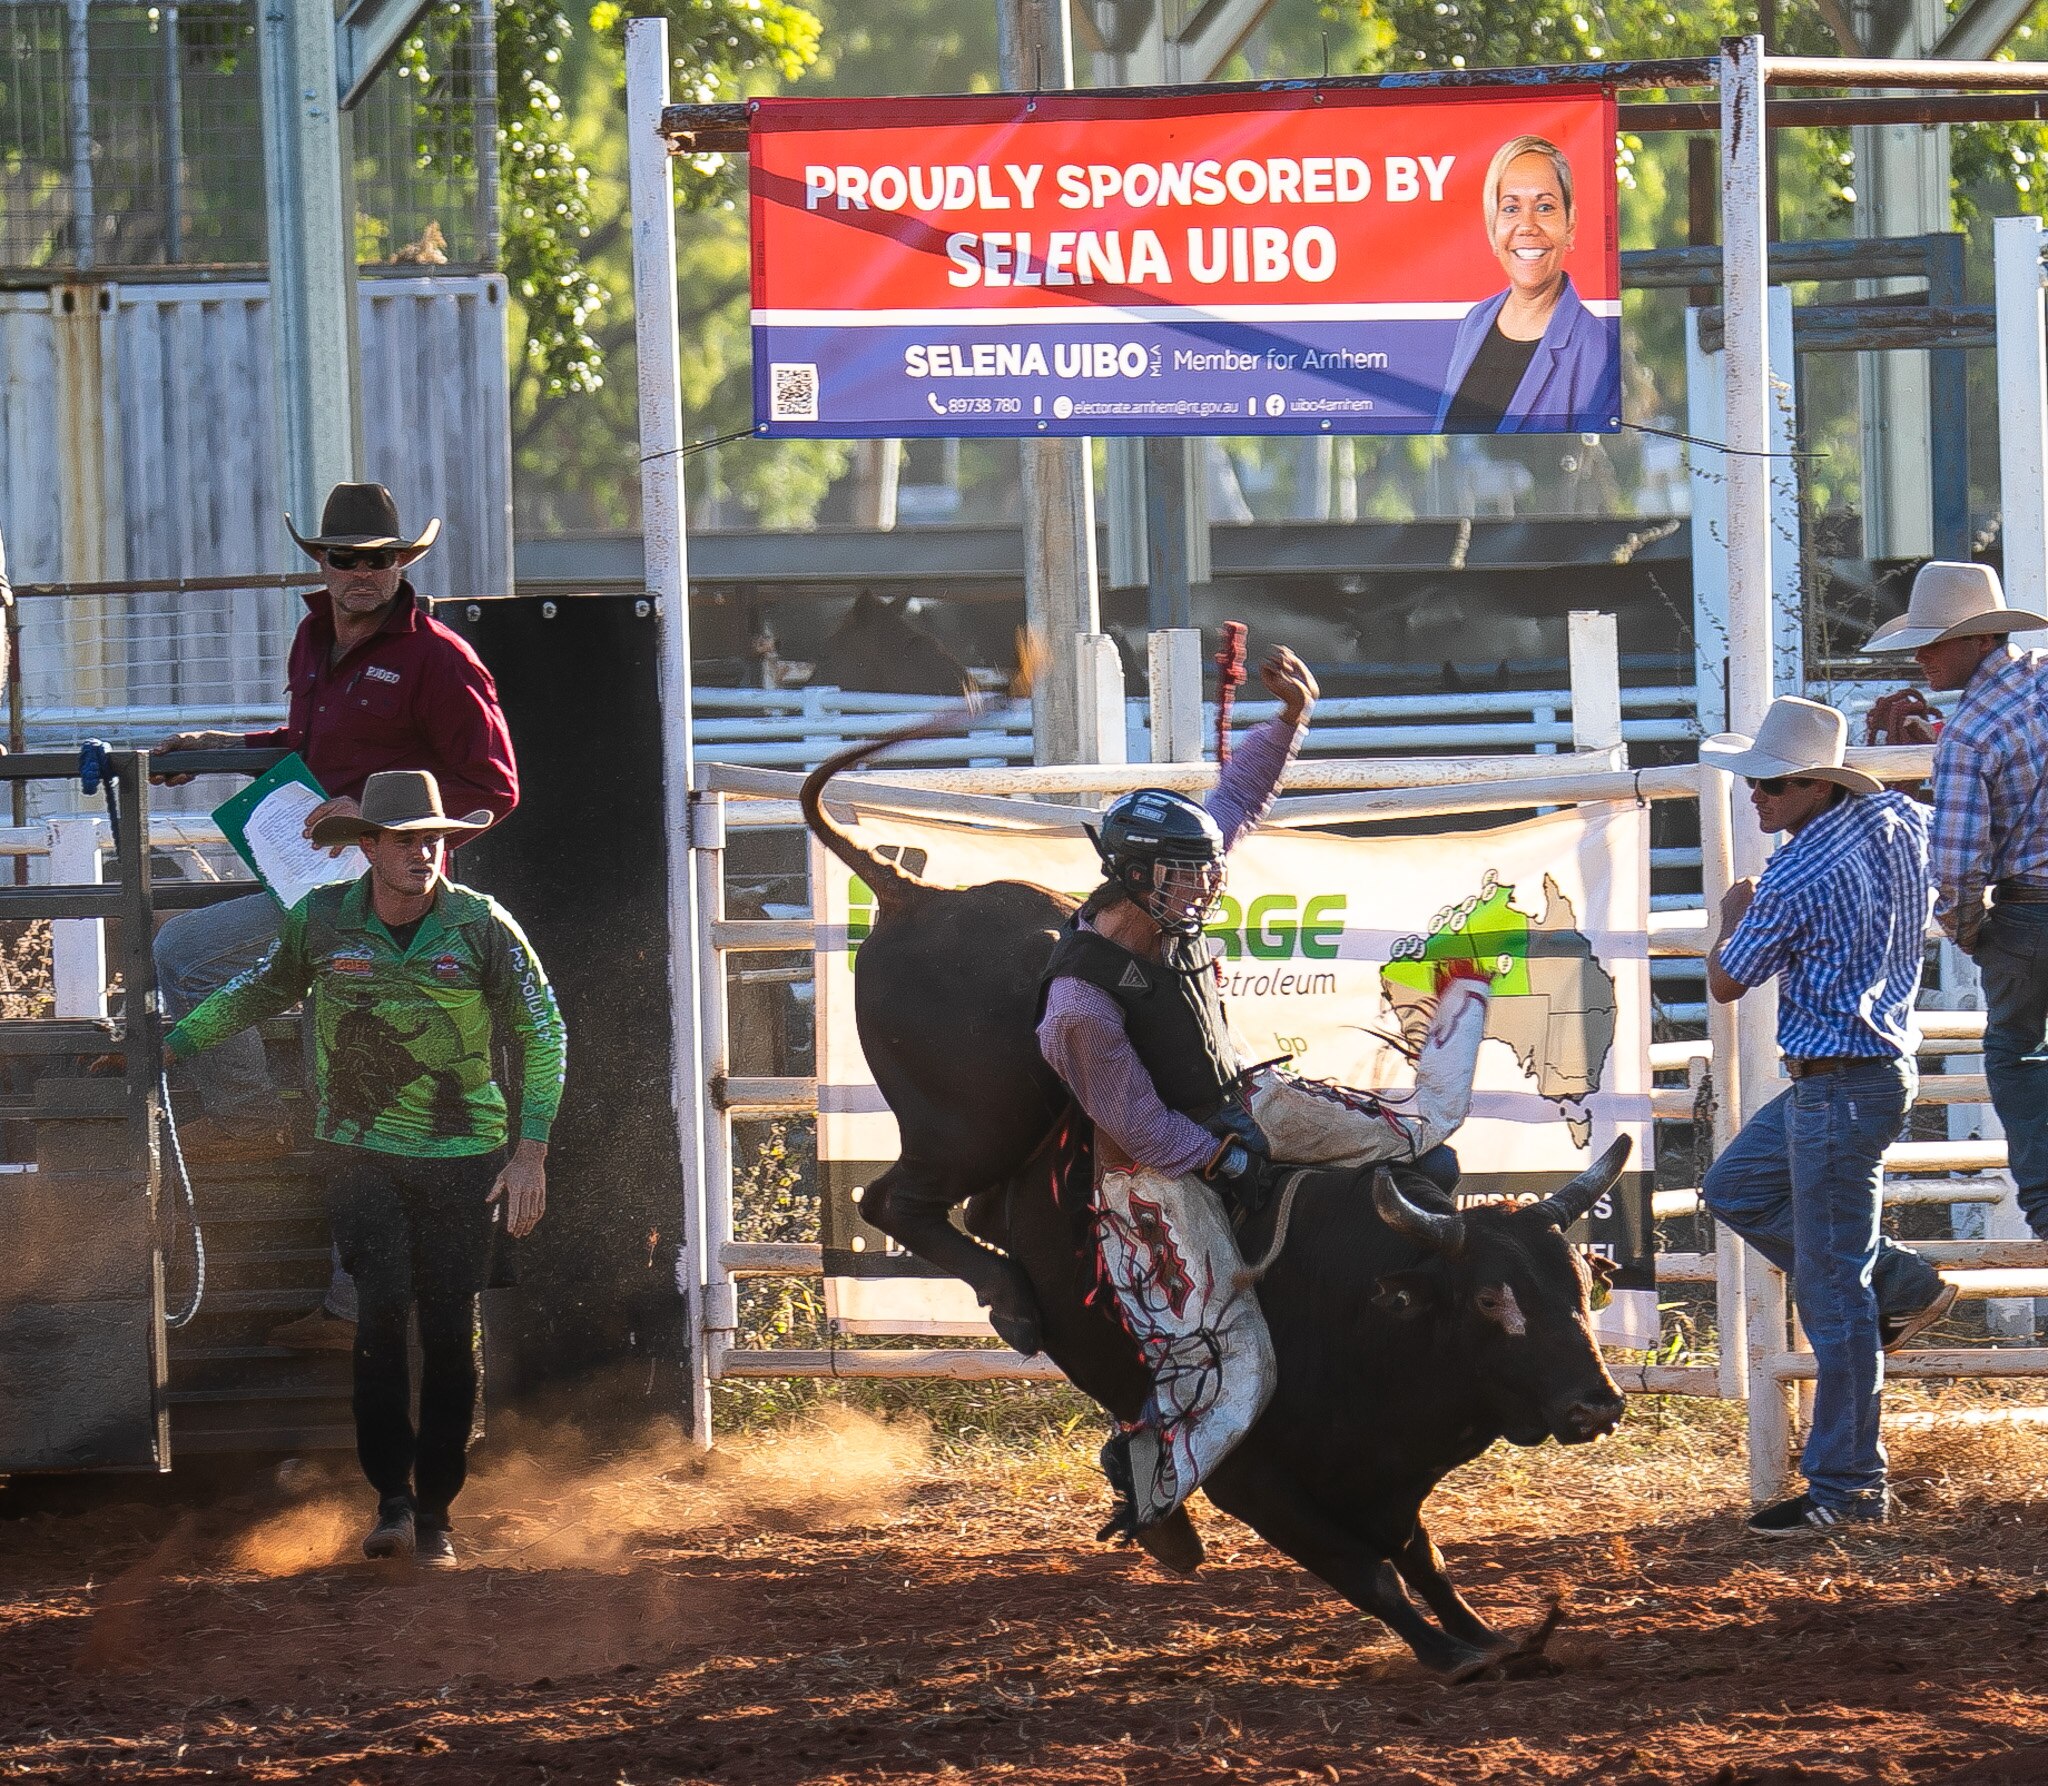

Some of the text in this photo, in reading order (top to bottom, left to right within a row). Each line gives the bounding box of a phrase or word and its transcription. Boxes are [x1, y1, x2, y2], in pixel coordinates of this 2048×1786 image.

[805, 155, 1456, 211] PROUDLY SPONSORED BY
[945, 225, 1337, 288] SELENA UIBO
[904, 343, 1050, 378] SELENA
[1054, 342, 1148, 378] UIBO
[1173, 349, 1262, 371] Member
[1265, 348, 1298, 370] for
[1301, 348, 1389, 370] Arnhem
[948, 397, 1022, 414] 89738 780
[1217, 967, 1337, 998] etroleum
[1273, 1031, 1308, 1058] bp
